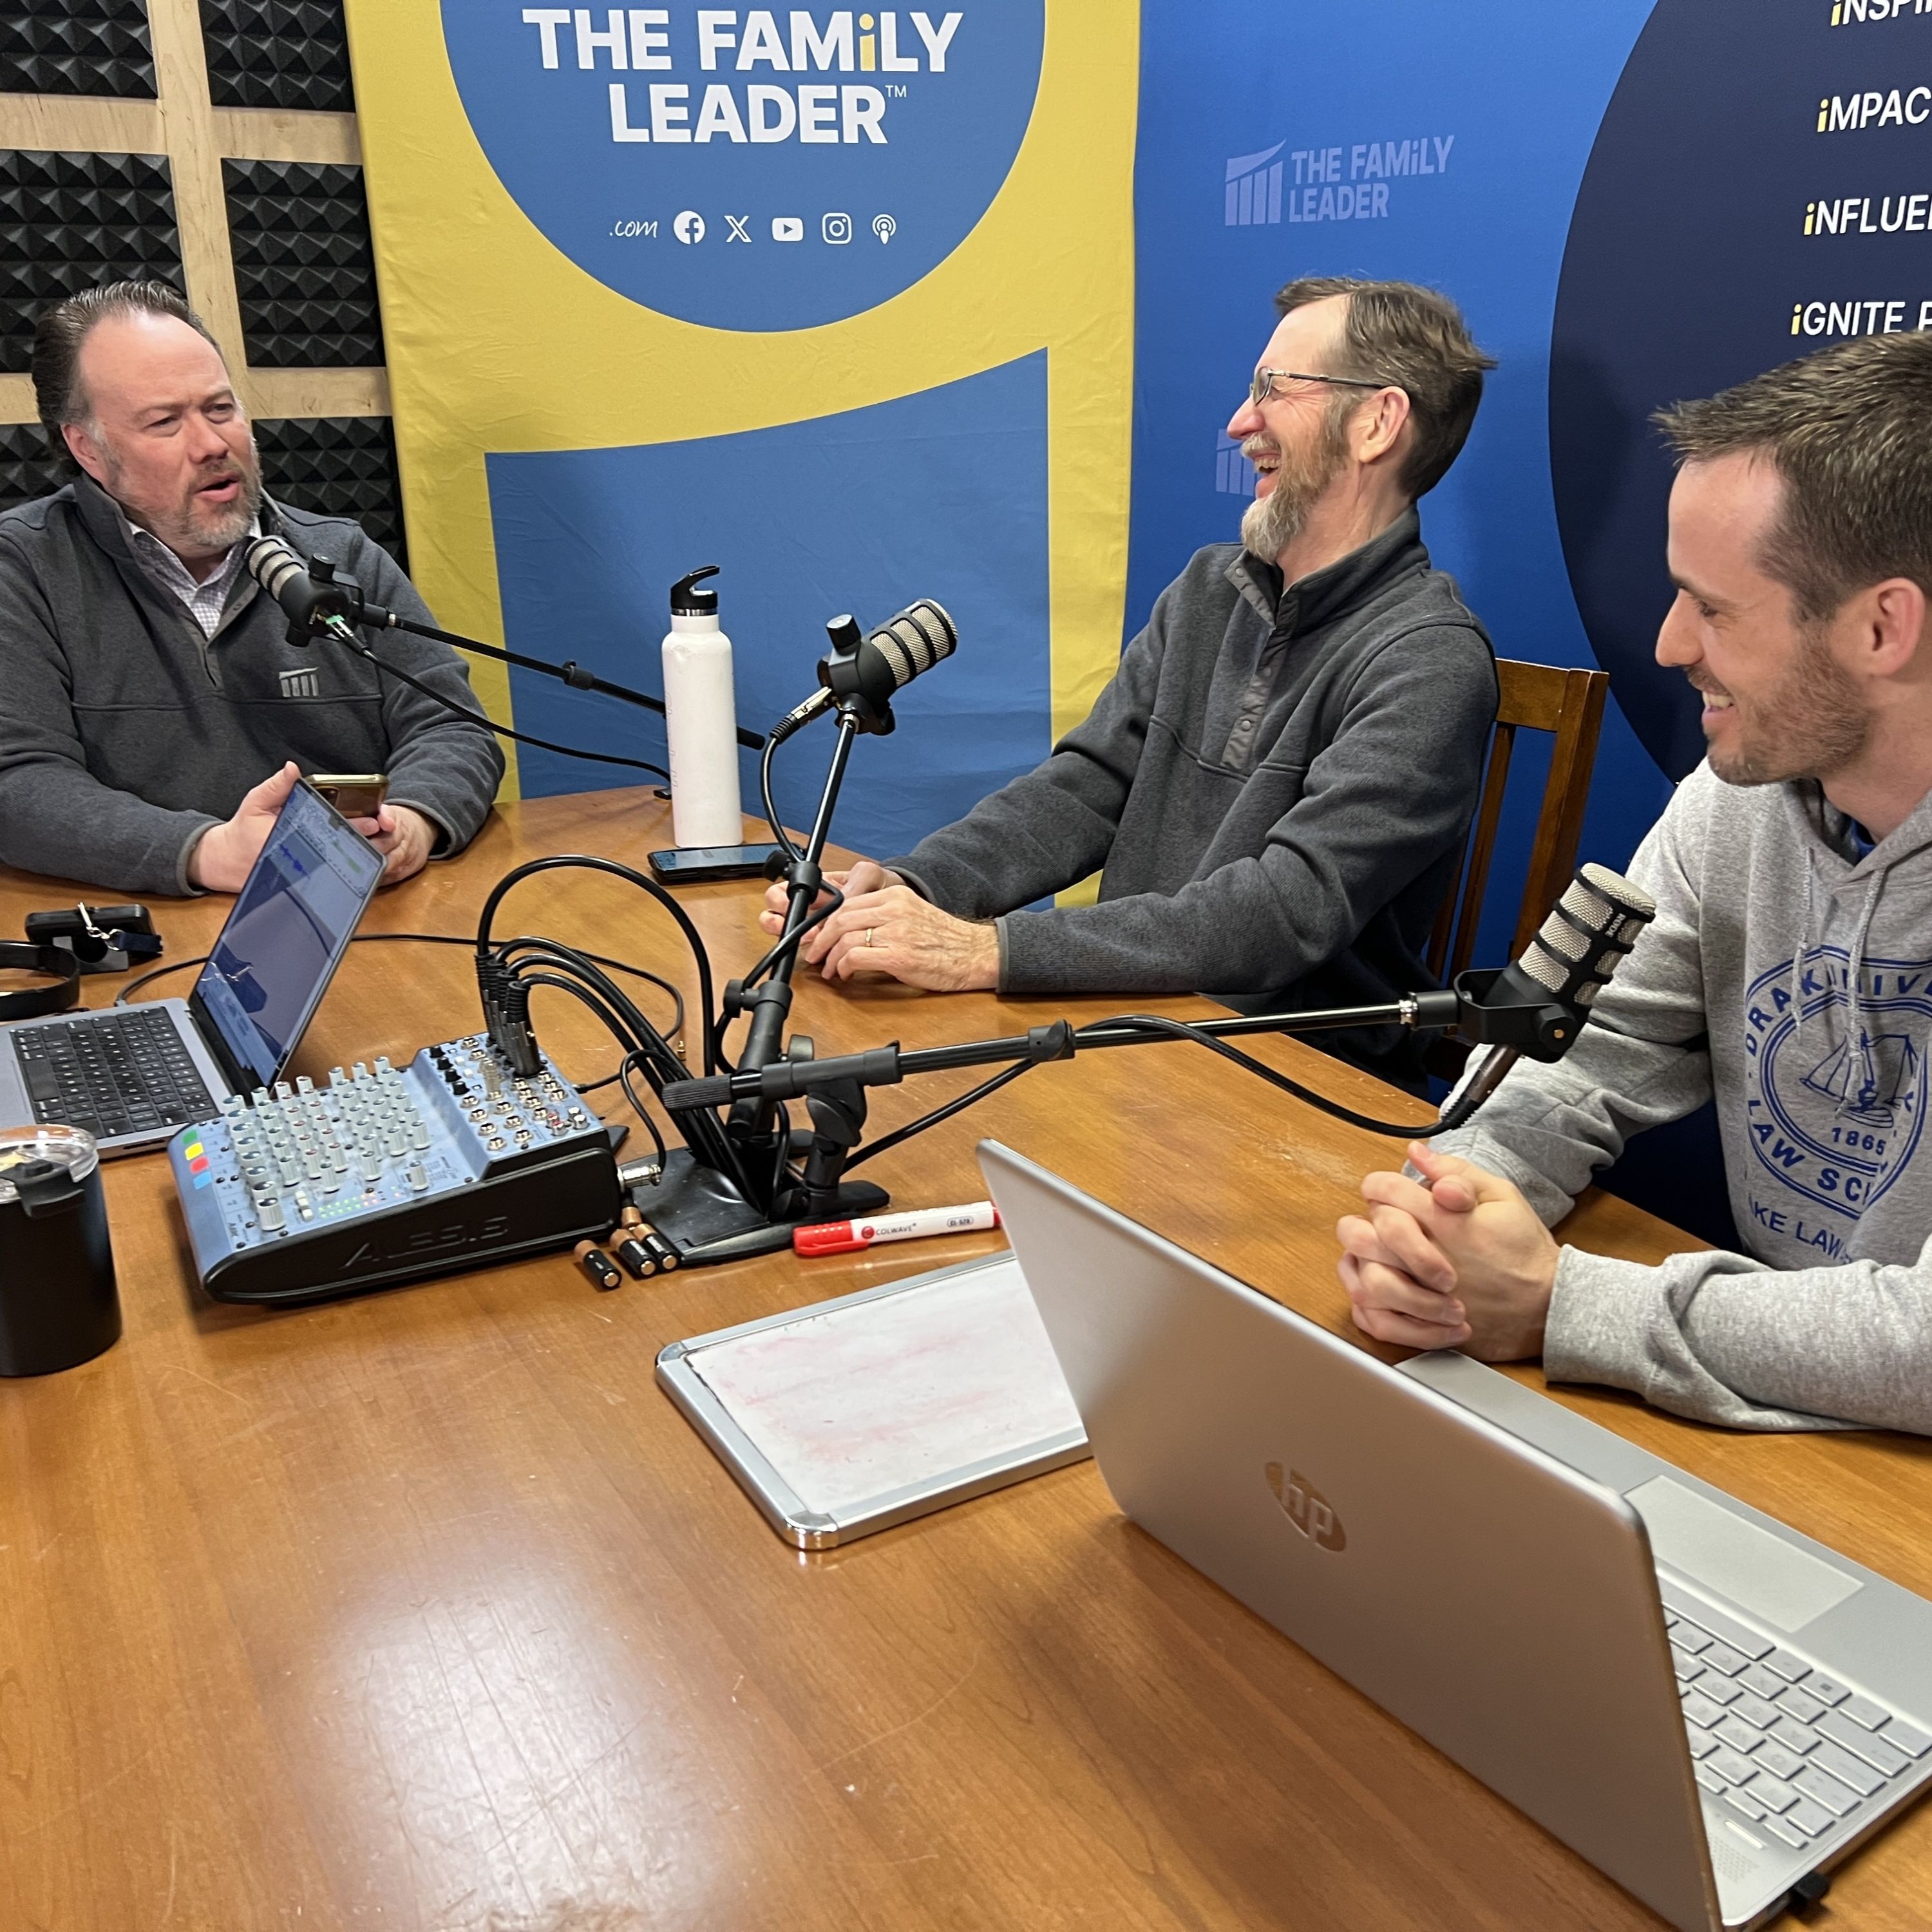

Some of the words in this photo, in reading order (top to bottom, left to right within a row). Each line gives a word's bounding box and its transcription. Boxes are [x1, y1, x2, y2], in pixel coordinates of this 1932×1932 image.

[522, 9, 672, 70] THE
[609, 84, 888, 144] LEADER
[1291, 147, 1343, 185] THE
[1289, 182, 1390, 223] LEADER
[1803, 194, 1932, 236] iNFLUE
[609, 219, 658, 238] .com
[1745, 967, 1835, 1057] DRAK
[1747, 1099, 1806, 1168] LAW
[1817, 1168, 1872, 1205] SC
[1831, 1127, 1886, 1156] 1865
[1750, 1193, 1788, 1234] KE
